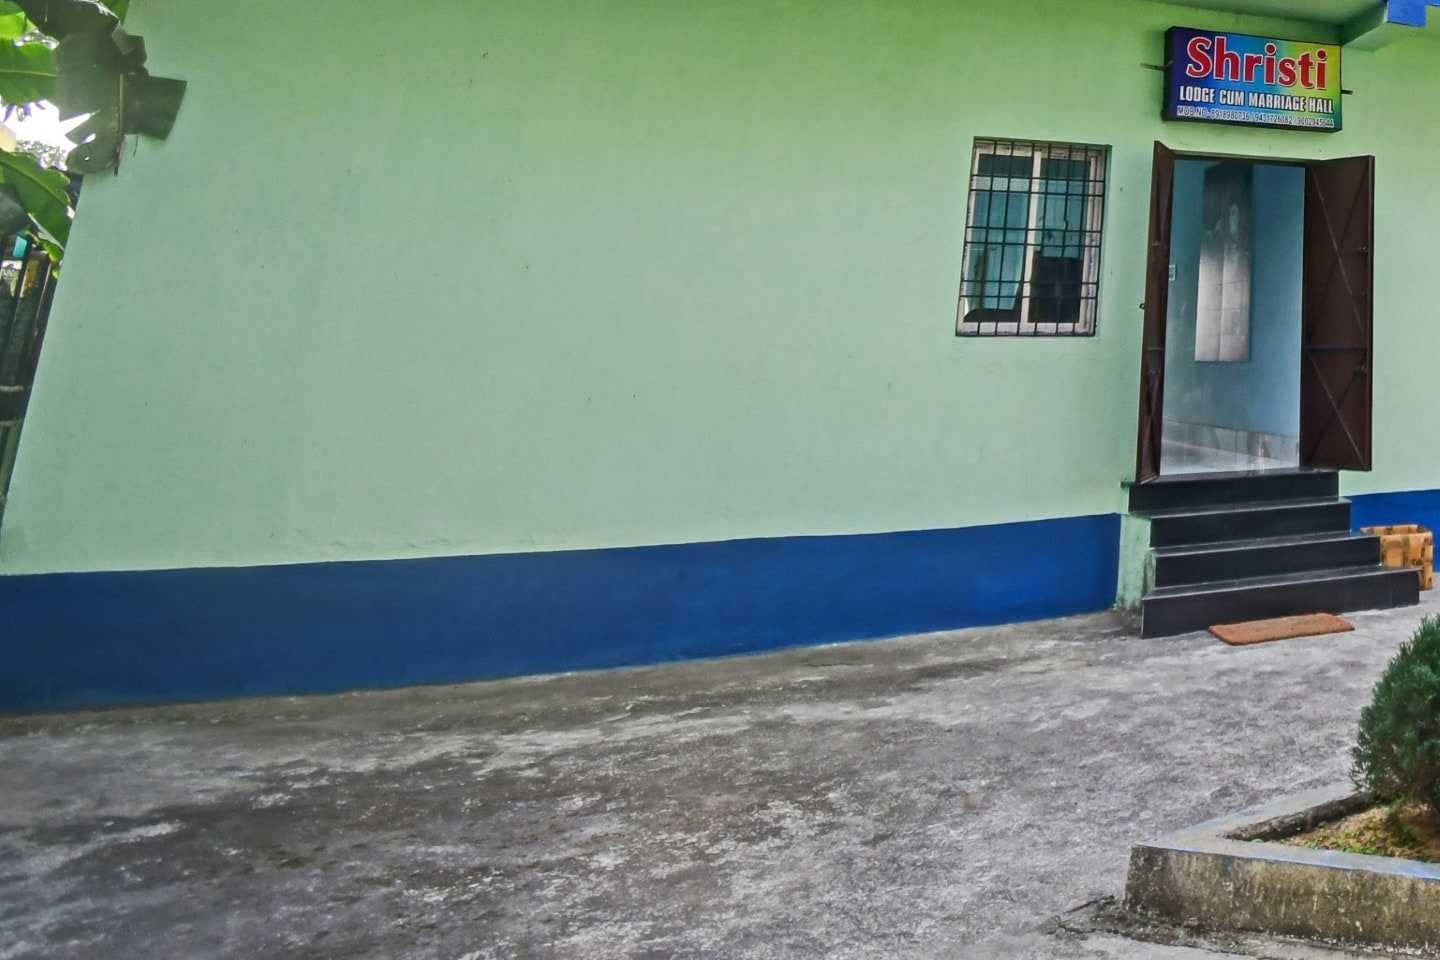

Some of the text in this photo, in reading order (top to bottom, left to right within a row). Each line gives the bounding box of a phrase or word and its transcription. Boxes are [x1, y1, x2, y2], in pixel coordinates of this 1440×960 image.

[1186, 36, 1327, 90] Shristi
[1179, 86, 1334, 114] LODGE CUM MARRIAGE HALL
